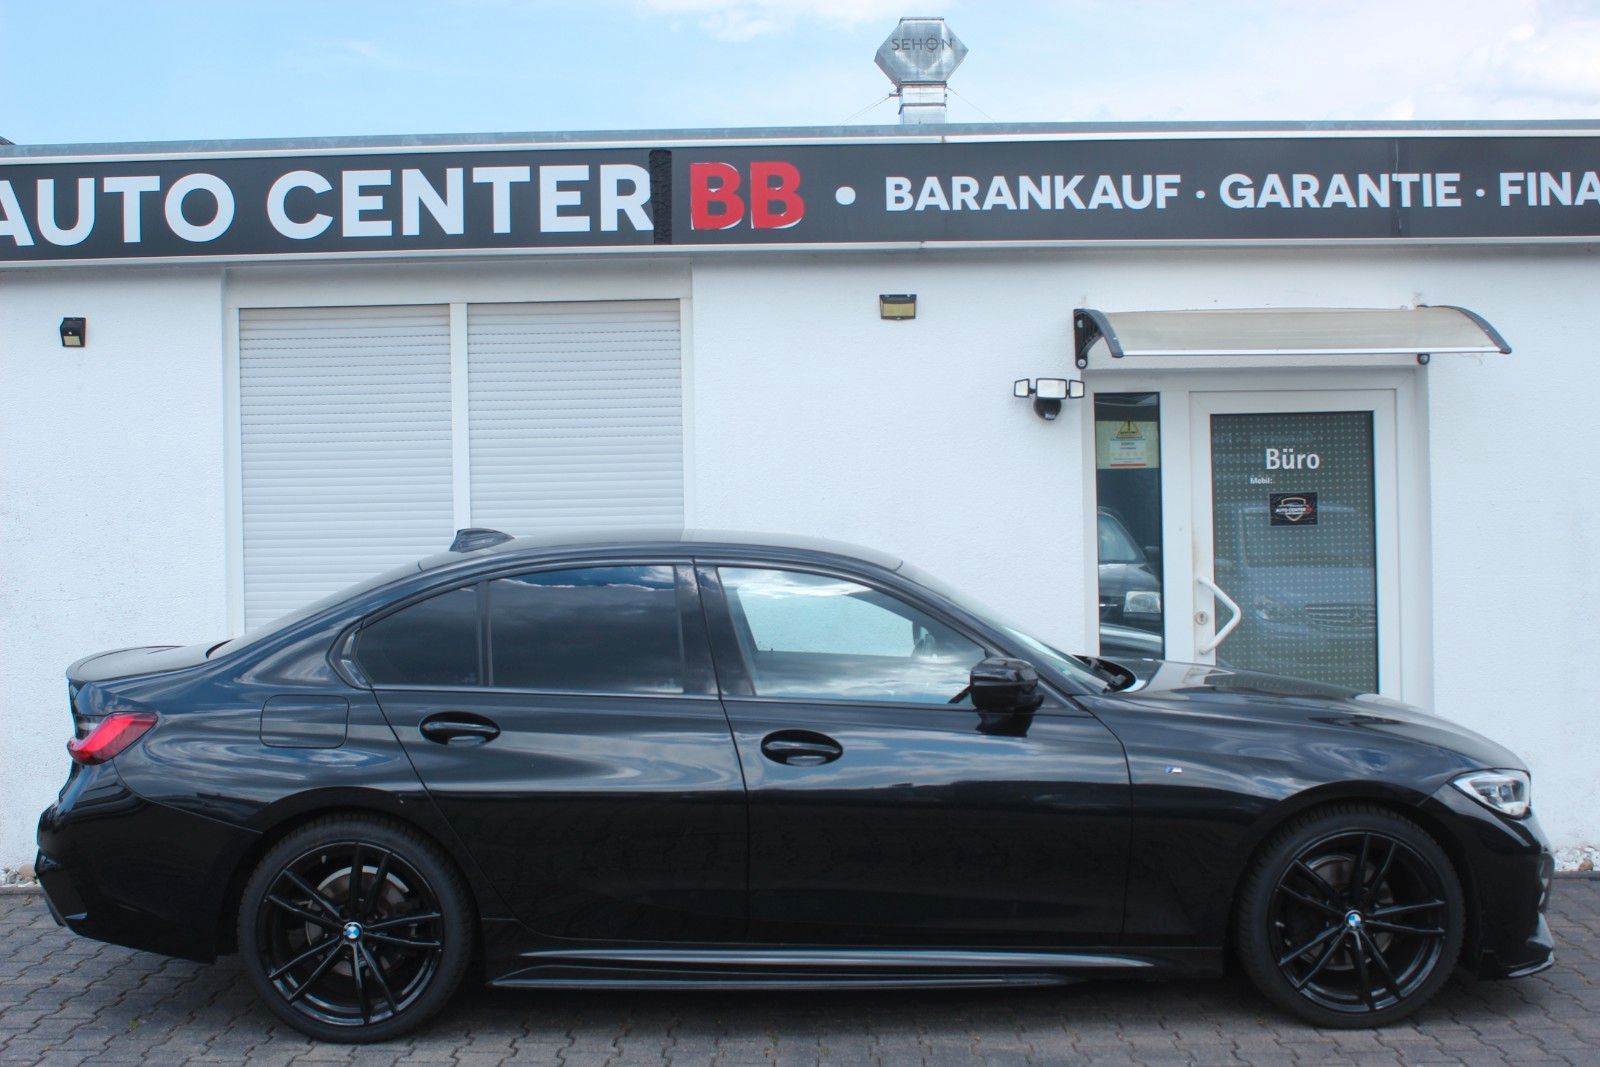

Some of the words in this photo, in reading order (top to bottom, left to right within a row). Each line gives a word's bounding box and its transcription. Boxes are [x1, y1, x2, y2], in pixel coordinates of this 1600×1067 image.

[266, 163, 654, 240] CENTER
[690, 161, 806, 231] BB
[885, 174, 1182, 212] BARANKAUF
[1219, 173, 1462, 209] GARANTIE
[1499, 171, 1600, 207] FINA
[1265, 447, 1321, 470] Büro
[1250, 477, 1273, 485] Mobil:
